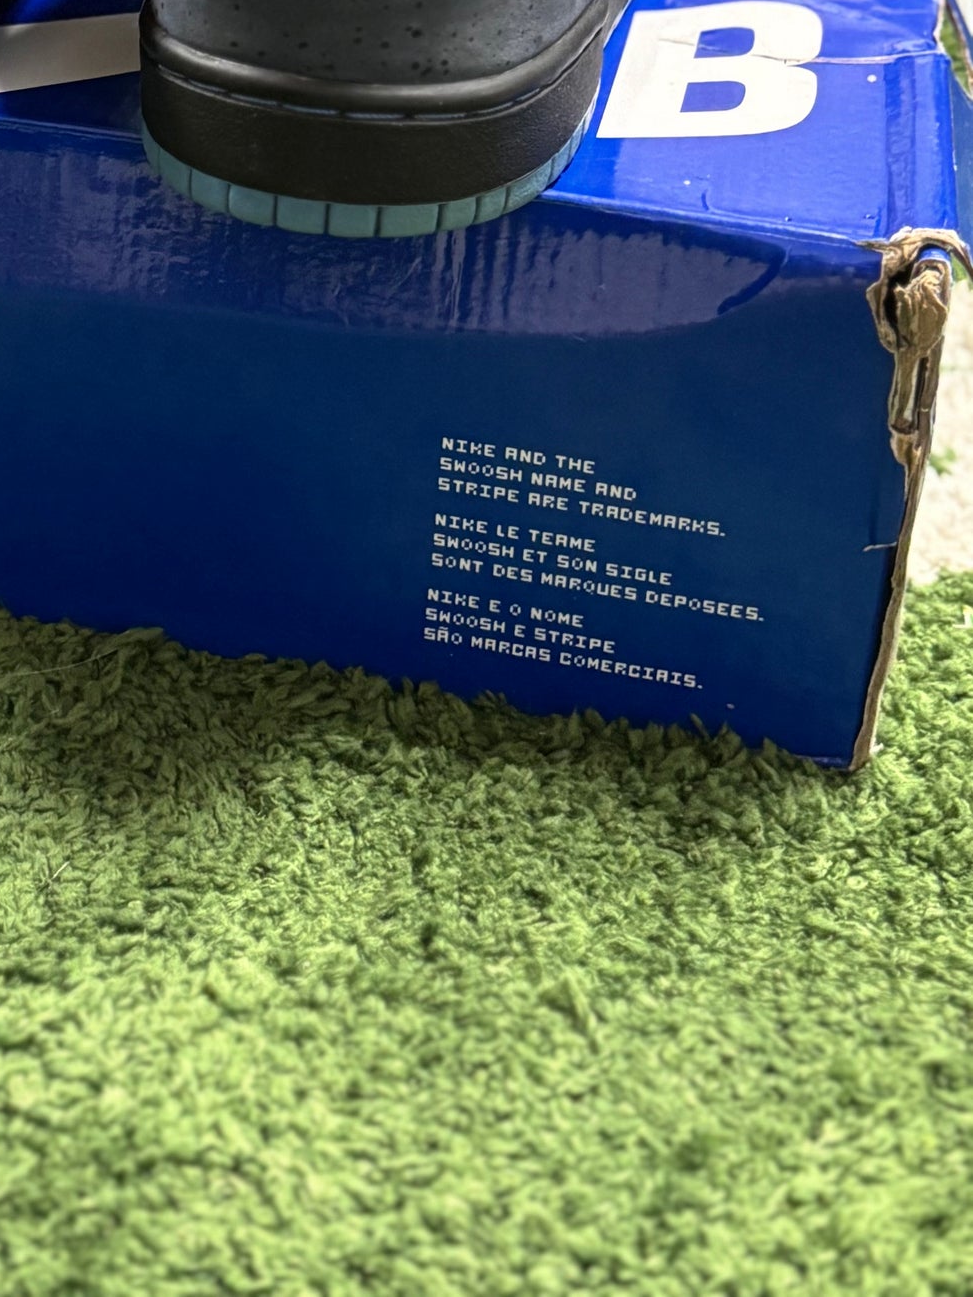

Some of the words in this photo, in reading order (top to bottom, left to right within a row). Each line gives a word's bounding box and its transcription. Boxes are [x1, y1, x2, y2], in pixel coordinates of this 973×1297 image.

[439, 457, 523, 482] SWOOSH
[531, 472, 586, 493] NAME
[595, 482, 637, 501] AND
[441, 437, 496, 458] NIKE
[504, 447, 546, 466] AND
[555, 455, 595, 474] THE
[438, 477, 520, 503] STRIPE
[528, 492, 569, 511] ARE
[579, 501, 726, 537] TRADEMARKS.
[434, 513, 488, 534] NIKE
[496, 524, 520, 540] LE
[528, 529, 596, 552] TEAME
[433, 533, 515, 559] SWOOSH
[522, 548, 547, 564] ET
[556, 554, 598, 573] SON
[605, 563, 672, 586] SIGLE
[427, 588, 480, 609] NIKE
[488, 599, 501, 613] E
[509, 603, 522, 617] O
[530, 607, 584, 628] NOME
[431, 552, 484, 573] SONT
[492, 564, 533, 583] DES
[540, 572, 637, 601] MARQUES
[645, 590, 765, 622] DEPOSEES.
[425, 607, 506, 633] SWOOSH
[513, 624, 526, 638] E
[534, 627, 616, 654] STRIPE
[423, 626, 463, 645] SÃO
[470, 635, 551, 662] MARCAS
[559, 652, 703, 690] COMERCIAIS.
